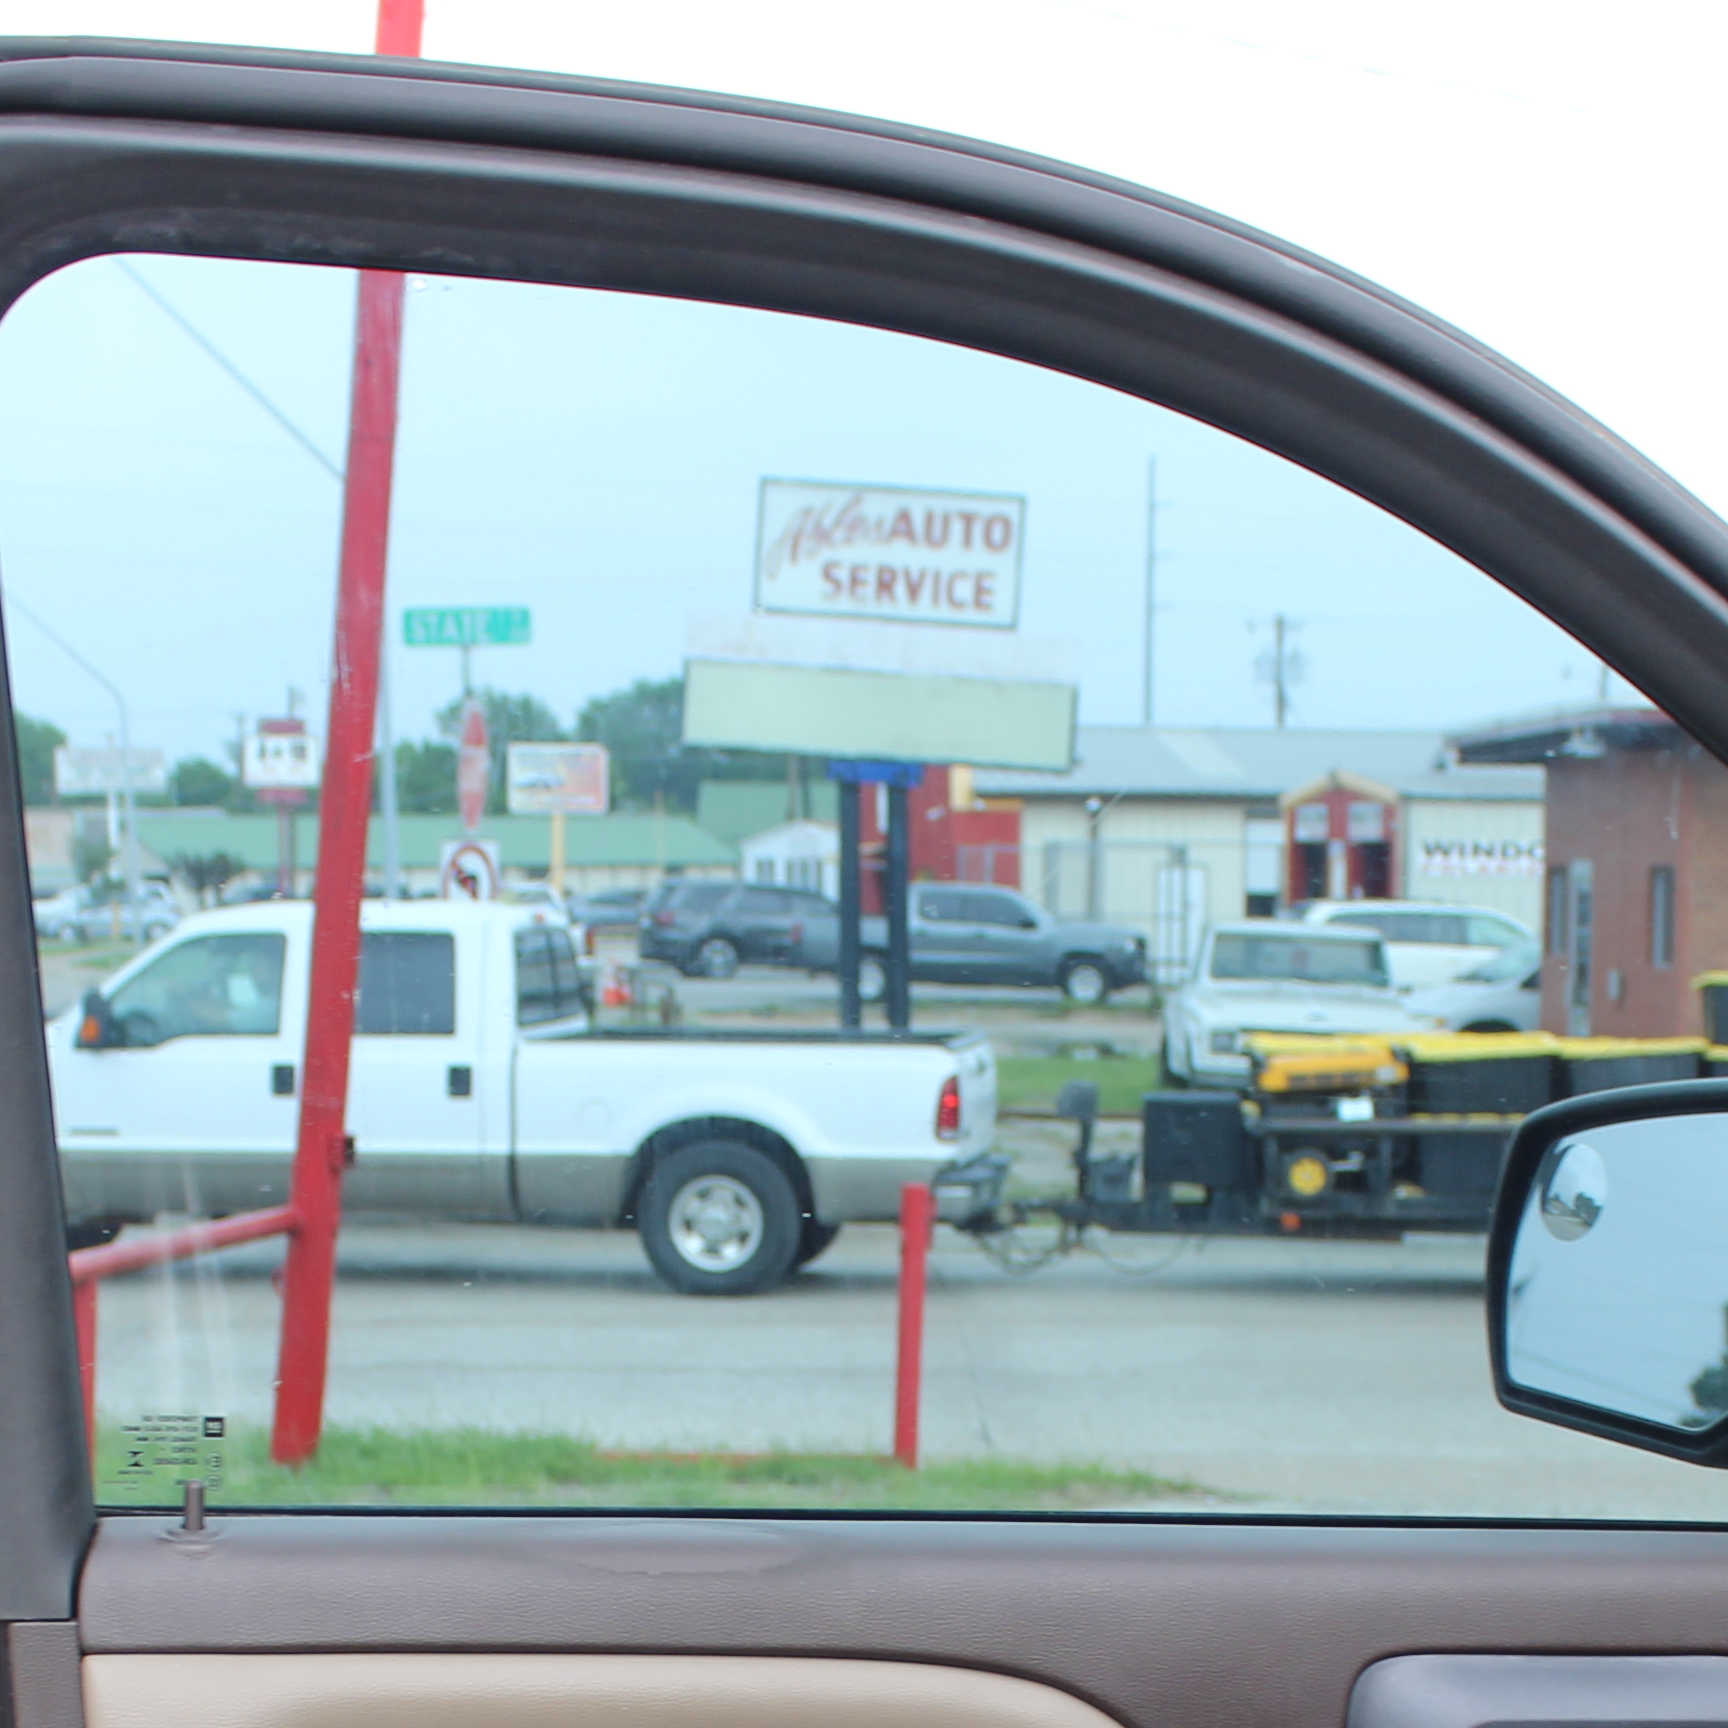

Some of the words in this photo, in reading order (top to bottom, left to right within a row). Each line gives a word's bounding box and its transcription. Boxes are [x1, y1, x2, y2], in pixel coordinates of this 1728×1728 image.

[889, 508, 1013, 553] AUTO
[821, 558, 998, 611] SERVICE
[410, 612, 493, 643] STATE
